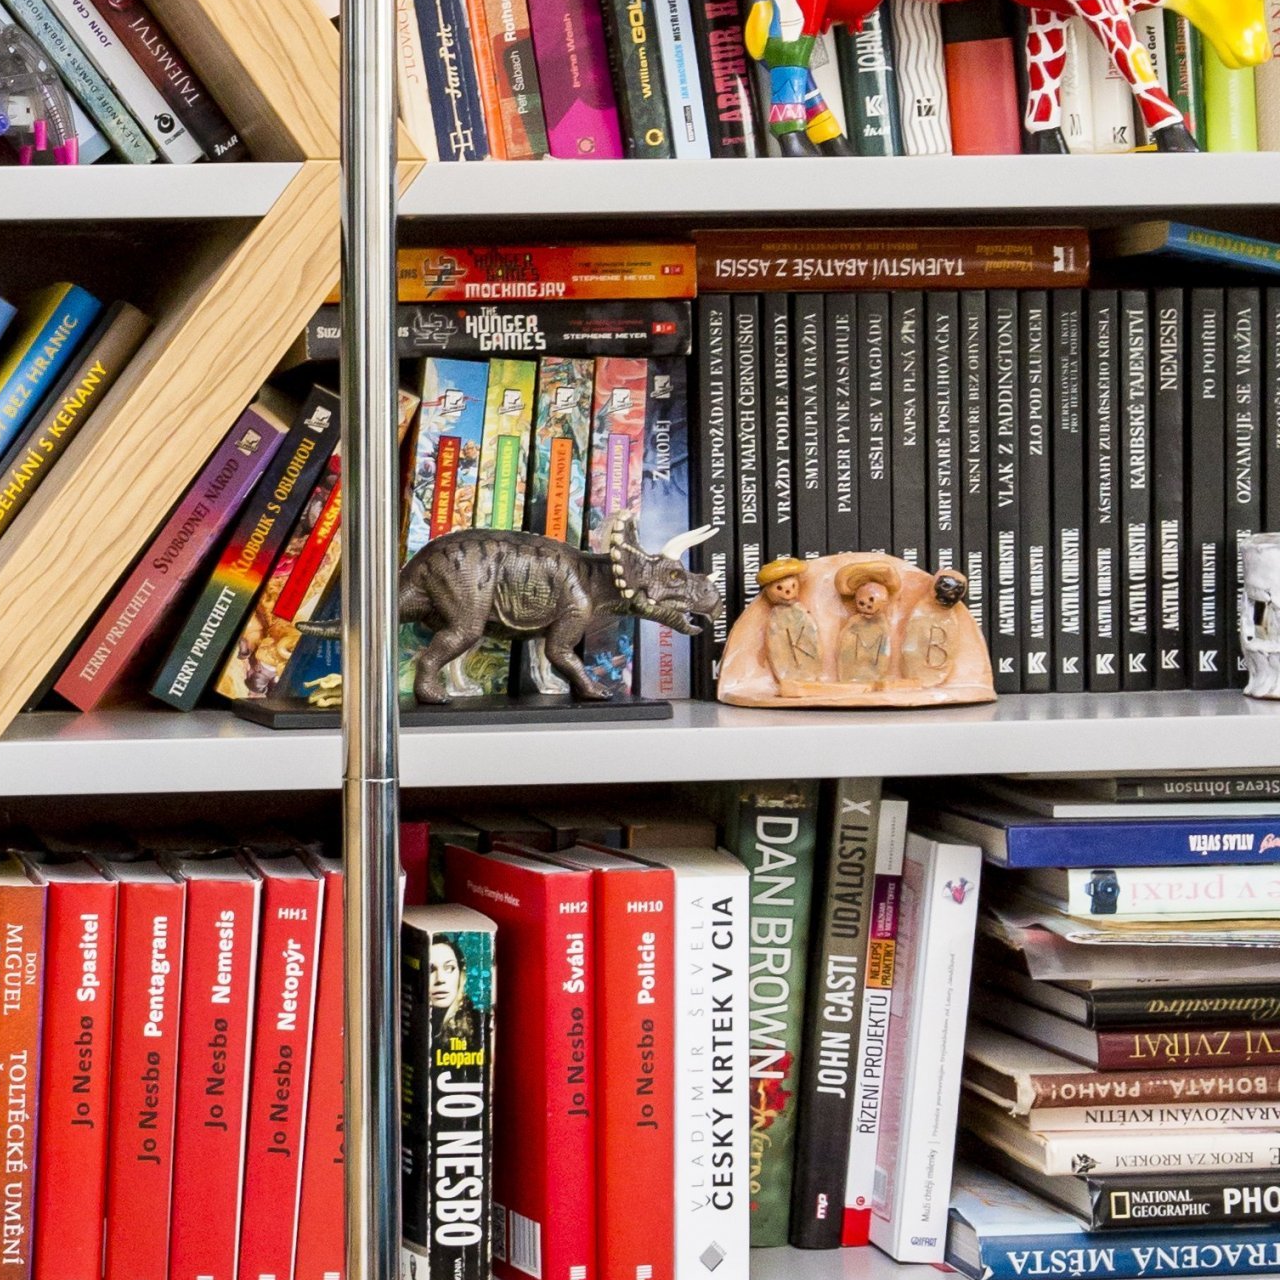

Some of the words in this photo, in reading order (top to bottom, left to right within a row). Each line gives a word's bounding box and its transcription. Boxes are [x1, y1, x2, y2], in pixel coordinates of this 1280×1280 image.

[131, 17, 202, 108] TAJEMSTVÍ
[465, 282, 566, 299] MOCKINGJAY
[715, 258, 768, 277] ASSISI
[775, 259, 786, 276] Z
[872, 258, 966, 280] TAJEMSTVÍ
[465, 315, 538, 338] HUNGER
[479, 331, 547, 351] GAMES
[480, 306, 499, 318] THE
[995, 307, 1014, 437] PADDINGTONU
[1160, 308, 1178, 392] NEMESIS
[38, 435, 54, 454] S
[51, 359, 109, 441] KEŇANY
[274, 438, 317, 504] OBLOHOU
[998, 442, 1014, 456] Z
[268, 502, 281, 516] S
[998, 461, 1015, 508] VLAK
[228, 512, 278, 578] KLOBOUK
[169, 654, 195, 699] TERRY
[191, 585, 237, 661] PRATCHETT
[842, 799, 872, 816] X
[752, 815, 799, 906] DAN
[831, 824, 869, 939] UDÁLOSTI
[278, 907, 308, 921] HH1
[627, 900, 664, 913] HH10
[711, 896, 734, 950] CIA
[3, 922, 24, 1016] MIGUEL
[25, 951, 37, 985] DON
[76, 913, 99, 1002] Spasitel
[143, 915, 170, 1038] Pentagram
[211, 909, 235, 1005] Nemesis
[277, 938, 308, 1031] Netopýr
[638, 931, 657, 1006] Policie
[712, 963, 734, 986] V
[823, 954, 858, 1021] CASTI
[748, 918, 792, 1079] BROWN
[72, 1015, 94, 1097] Nesbø
[204, 1018, 228, 1098] Nesbø
[436, 1048, 485, 1068] Leopard
[449, 1037, 467, 1051] The
[636, 1018, 655, 1097] Nesbø
[712, 993, 734, 1095] KRTEK
[816, 1030, 851, 1098] JOHN
[5, 1050, 28, 1174] TOLTÉCKÉ
[71, 1101, 94, 1129] Jo
[139, 1050, 162, 1133] Nesbø
[269, 1044, 293, 1124] Nesbø
[435, 1071, 484, 1118] JO
[636, 1101, 659, 1129] Jo
[137, 1136, 161, 1165] Jo
[204, 1103, 228, 1132] Jo
[267, 1127, 290, 1157] Jo
[434, 1129, 483, 1247] NESBO
[705, 1111, 734, 1212] ČESKÝ
[2, 1182, 24, 1266] UMĚNÍ
[1131, 1190, 1193, 1203] NATIONAL
[1132, 1203, 1210, 1217] GEOGRAPHIC
